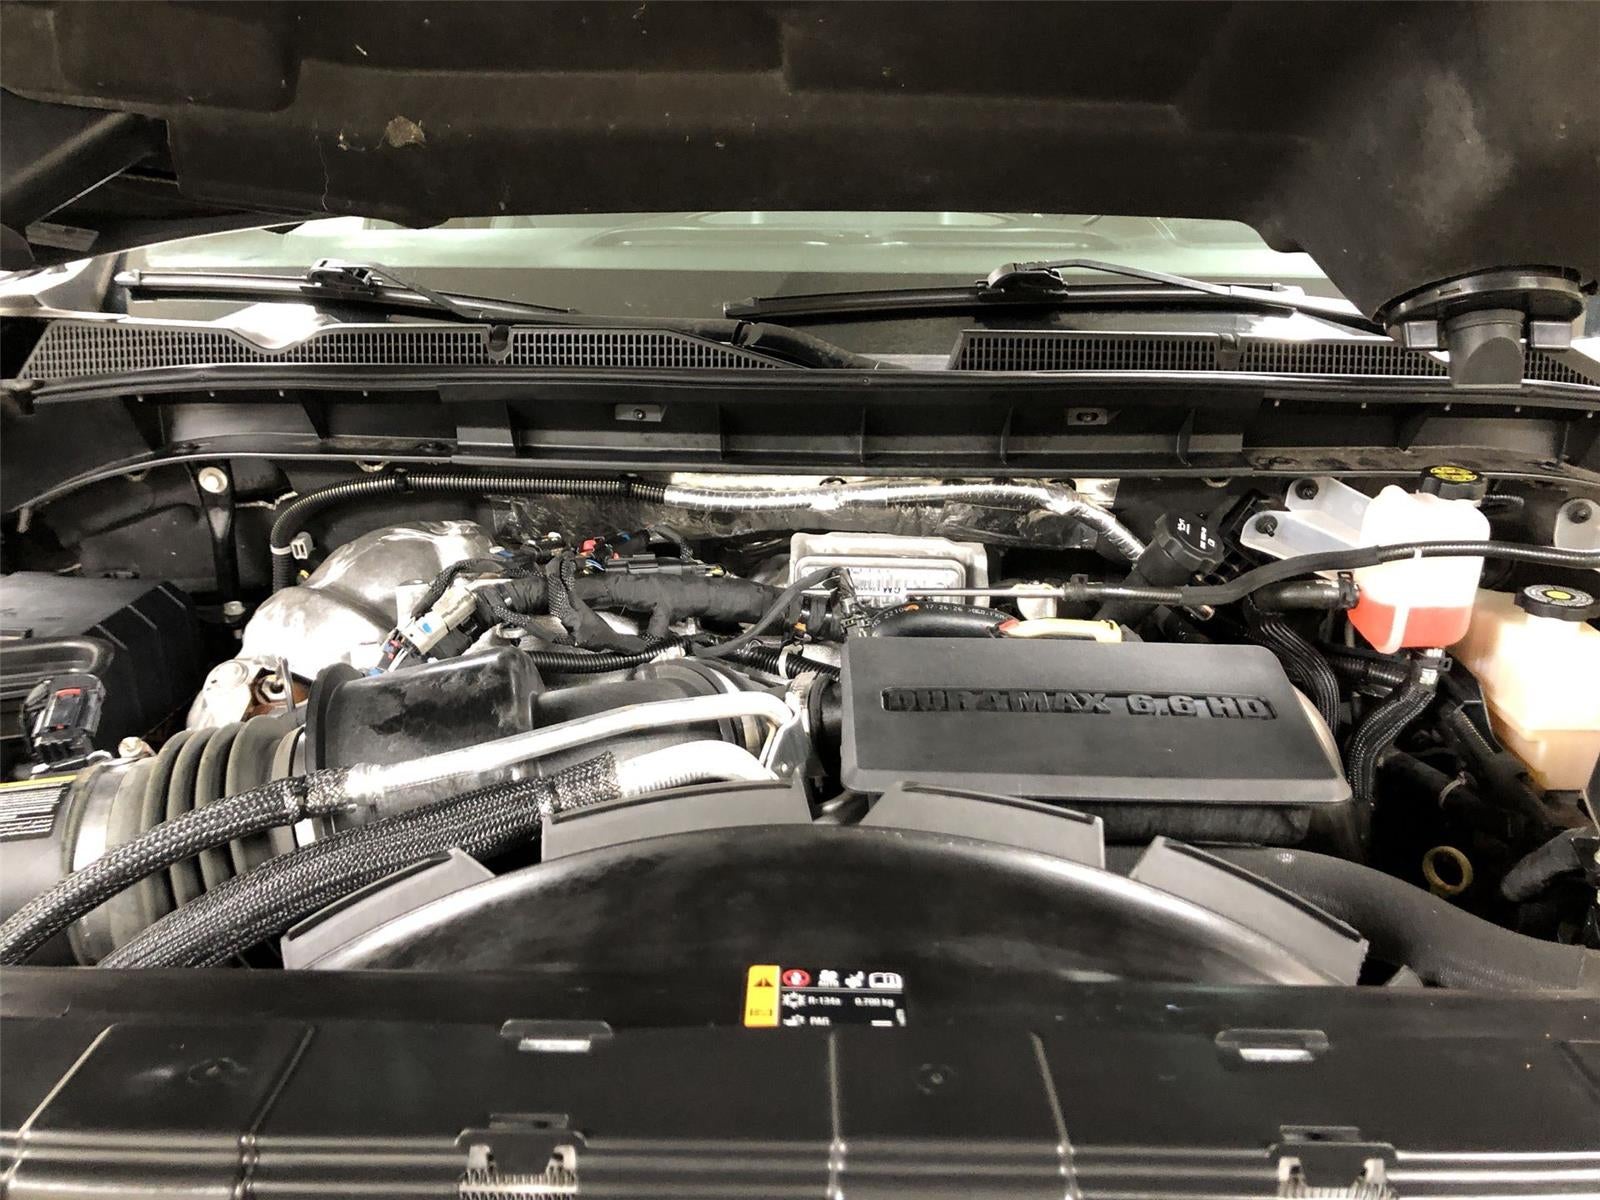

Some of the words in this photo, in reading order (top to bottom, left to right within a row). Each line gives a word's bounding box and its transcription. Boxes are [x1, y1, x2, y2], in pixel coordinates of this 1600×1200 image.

[888, 690, 1111, 714] DURAMAX
[1125, 693, 1199, 717] 6.6
[1206, 696, 1275, 720] HD
